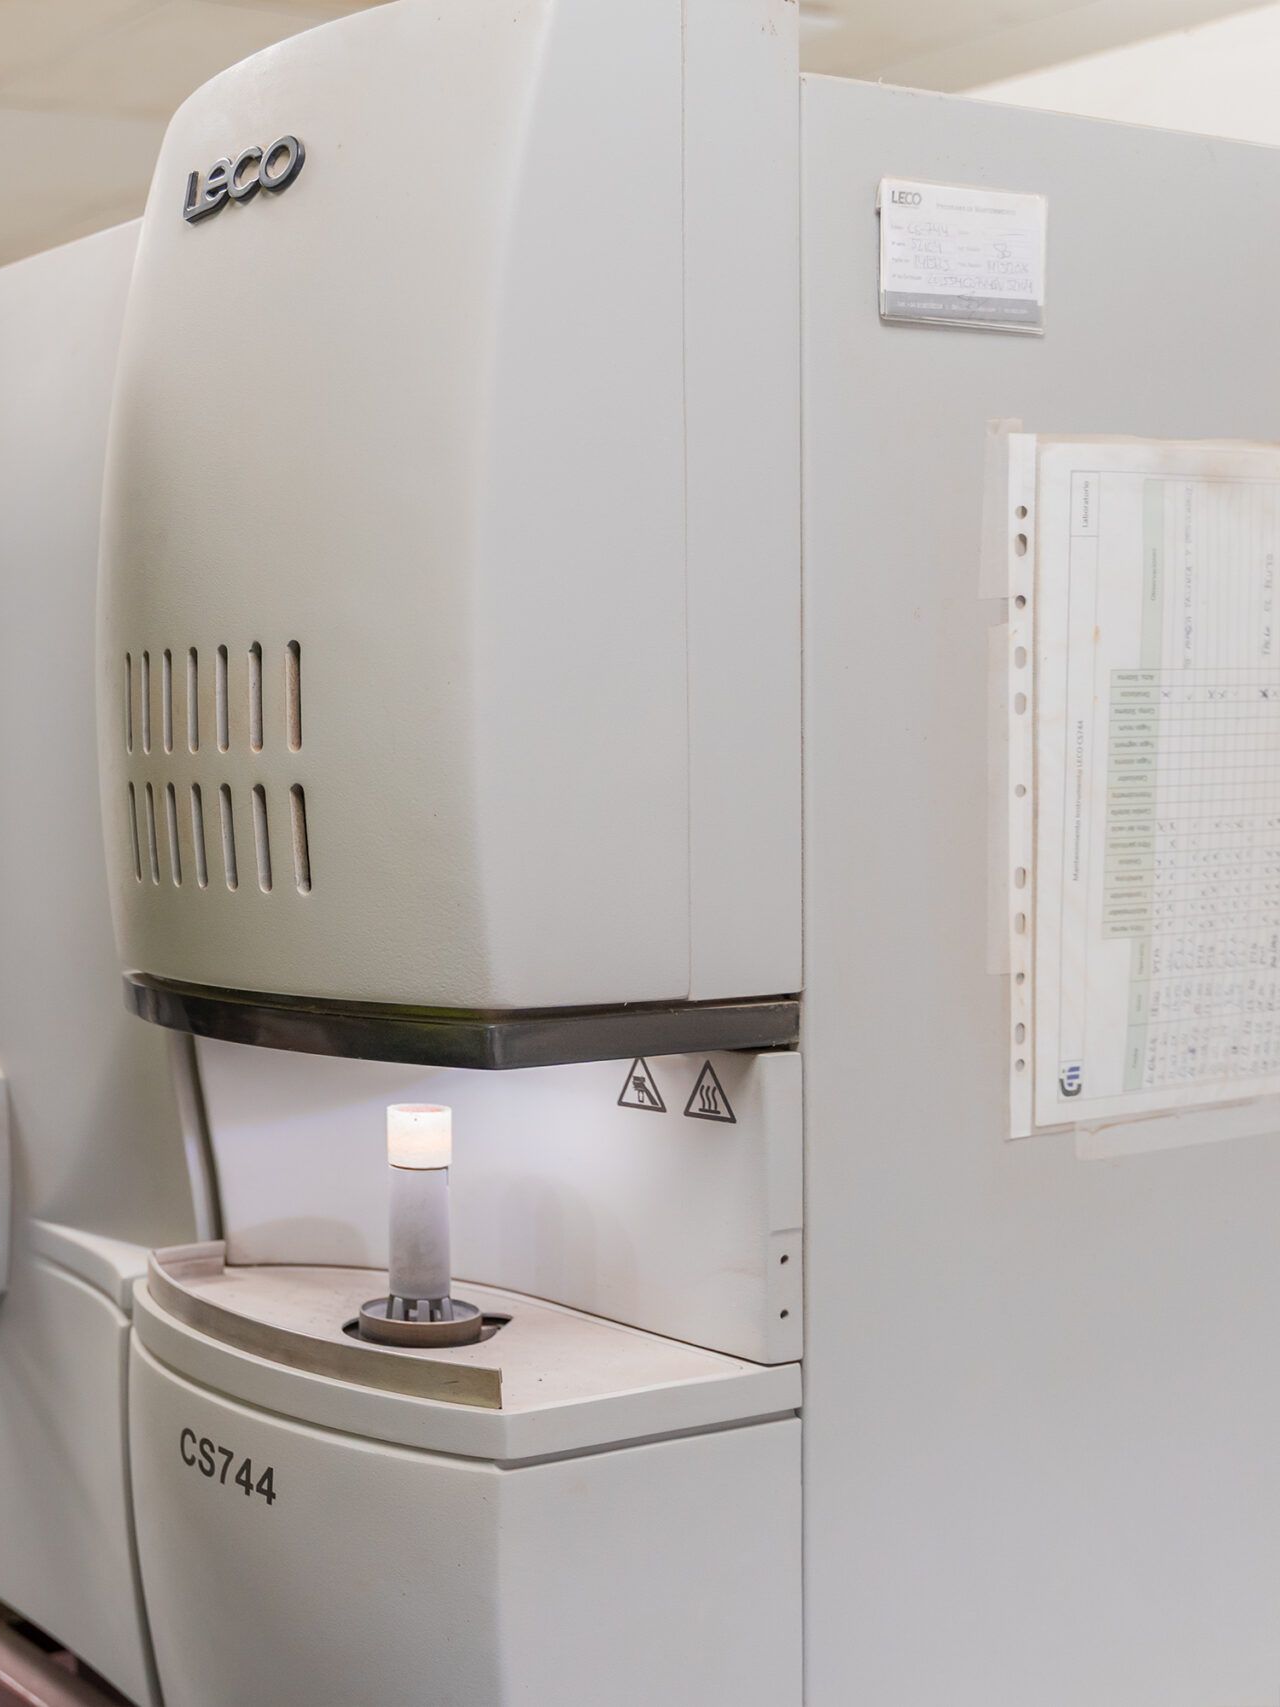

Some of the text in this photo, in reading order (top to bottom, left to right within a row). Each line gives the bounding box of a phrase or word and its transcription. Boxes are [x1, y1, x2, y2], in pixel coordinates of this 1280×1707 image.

[183, 134, 306, 224] LECO
[891, 190, 922, 206] LECO
[1081, 481, 1089, 528] Laboratorio
[180, 1427, 276, 1506] CS744
